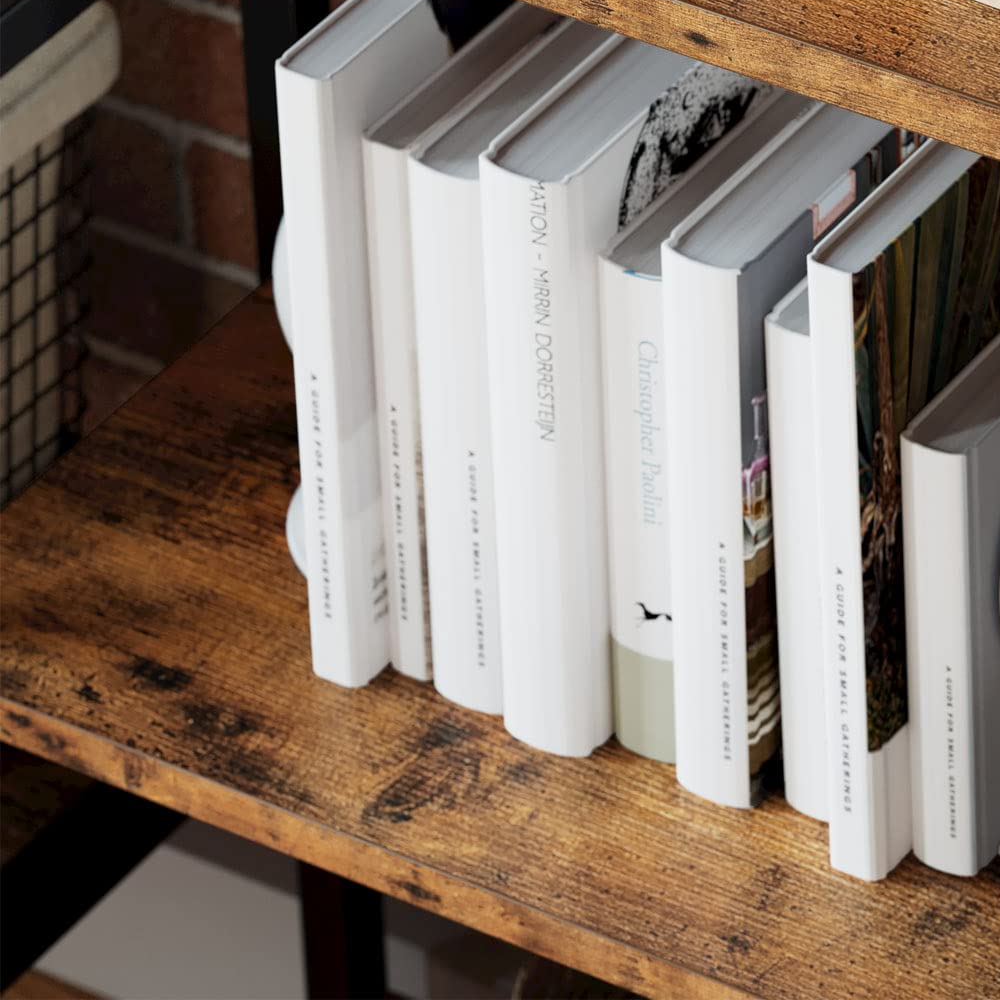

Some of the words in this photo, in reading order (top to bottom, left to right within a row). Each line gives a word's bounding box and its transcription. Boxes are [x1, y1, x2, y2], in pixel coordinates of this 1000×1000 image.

[533, 268, 551, 327] MIRRIN
[633, 340, 660, 454] Christopher
[314, 440, 322, 468] FOR
[641, 460, 663, 526] Paolini
[471, 509, 479, 534] FOR
[720, 601, 728, 627] FOR
[836, 583, 845, 627] GUIDE
[838, 634, 846, 663] FOR
[839, 670, 848, 716] SMALL
[841, 724, 852, 814] GATHERINGS
